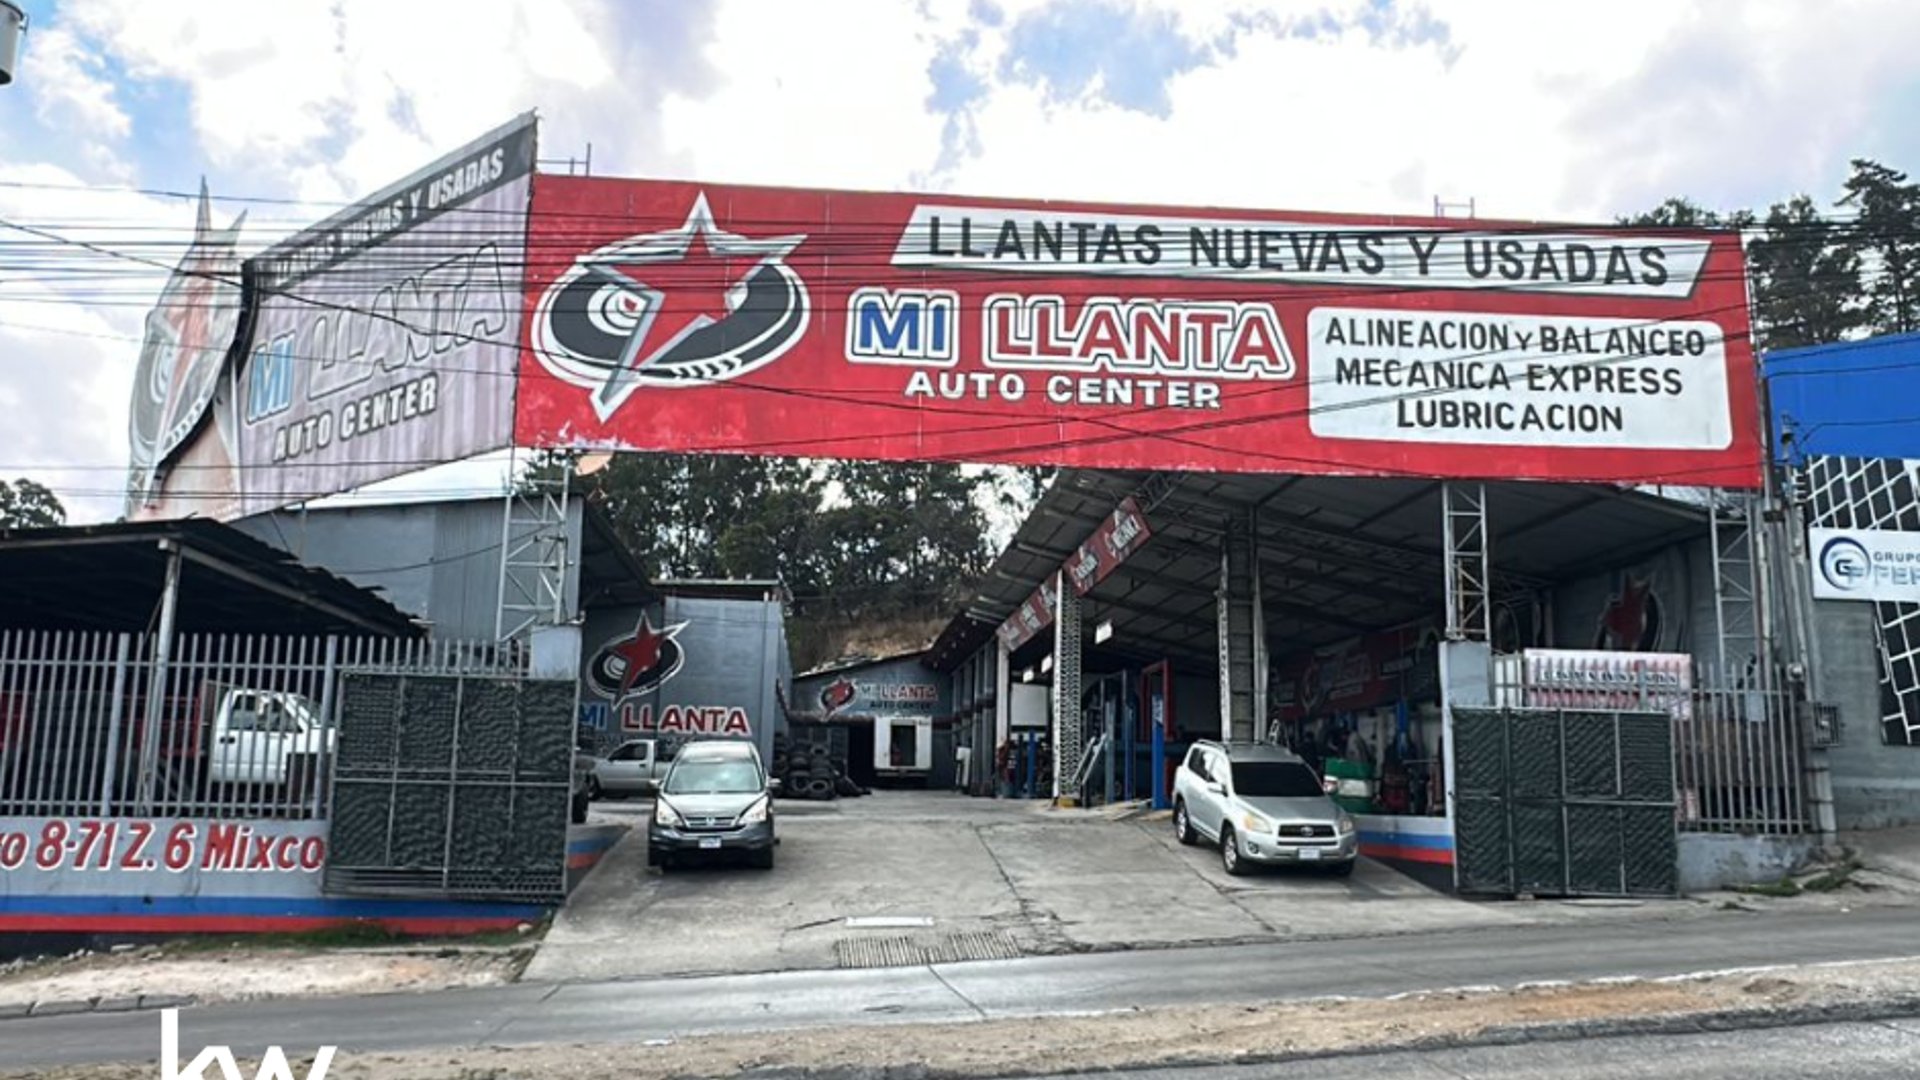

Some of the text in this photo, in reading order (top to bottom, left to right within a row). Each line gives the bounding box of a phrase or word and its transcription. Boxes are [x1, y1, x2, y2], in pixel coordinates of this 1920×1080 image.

[409, 188, 423, 219] Y
[428, 148, 504, 210] USADAS
[929, 216, 1668, 286] LLANTAS NUEVAS Y USADAS
[247, 331, 296, 425] MI
[307, 241, 507, 400] LLANTA
[850, 291, 1290, 373] MI LLANTA
[1325, 317, 1509, 350] ALINEACION
[1540, 325, 1706, 357] BALANCEO
[904, 371, 1221, 409] AUTO CENTER
[1336, 358, 1684, 396] MECANICA EXPRESS
[273, 371, 438, 464] AUTO CENTER
[1397, 400, 1624, 432] LUBRICACION
[881, 683, 938, 700] LLANTA
[622, 703, 752, 736] LLANTA
[36, 820, 119, 871] 8-71
[120, 822, 158, 871] Z.
[163, 821, 197, 872] 6
[201, 821, 326, 873] Mixco
